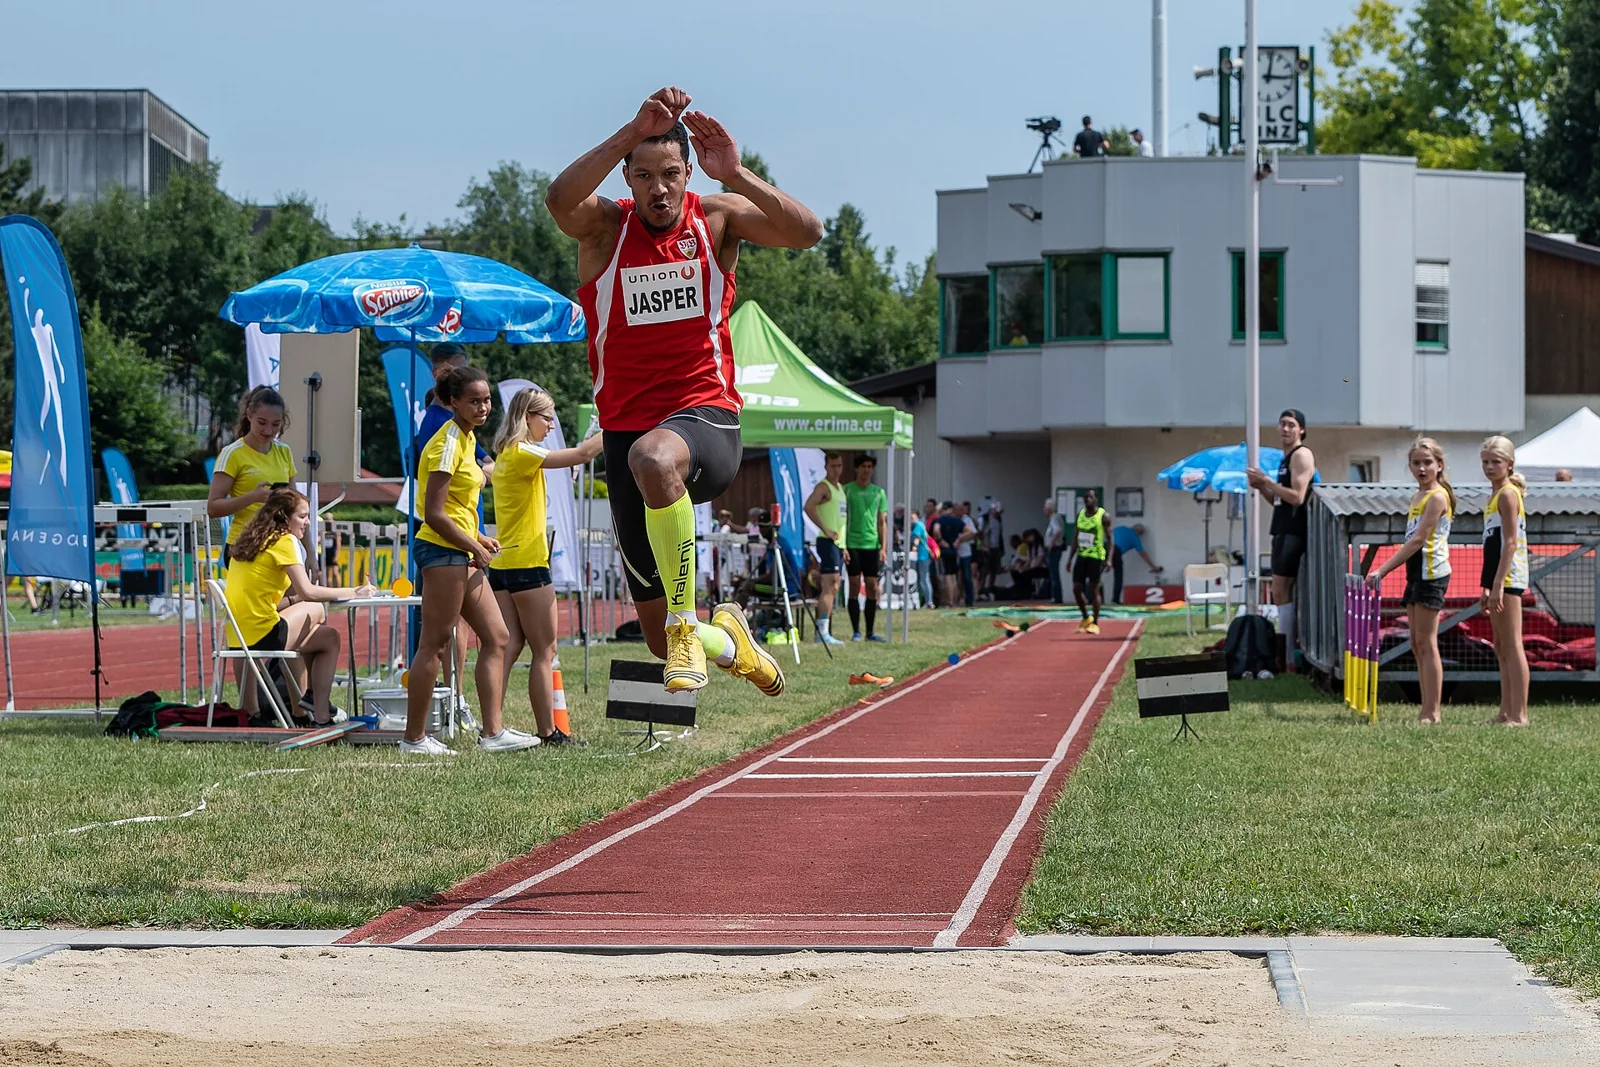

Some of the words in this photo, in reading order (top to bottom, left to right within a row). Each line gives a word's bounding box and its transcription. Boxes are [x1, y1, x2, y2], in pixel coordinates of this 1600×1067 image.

[1259, 105, 1293, 122] LC
[1258, 125, 1291, 139] INZ
[365, 287, 421, 316] Schöller
[628, 286, 698, 316] JASPER
[774, 416, 882, 432] www.erima.eu
[1145, 586, 1165, 603] 2
